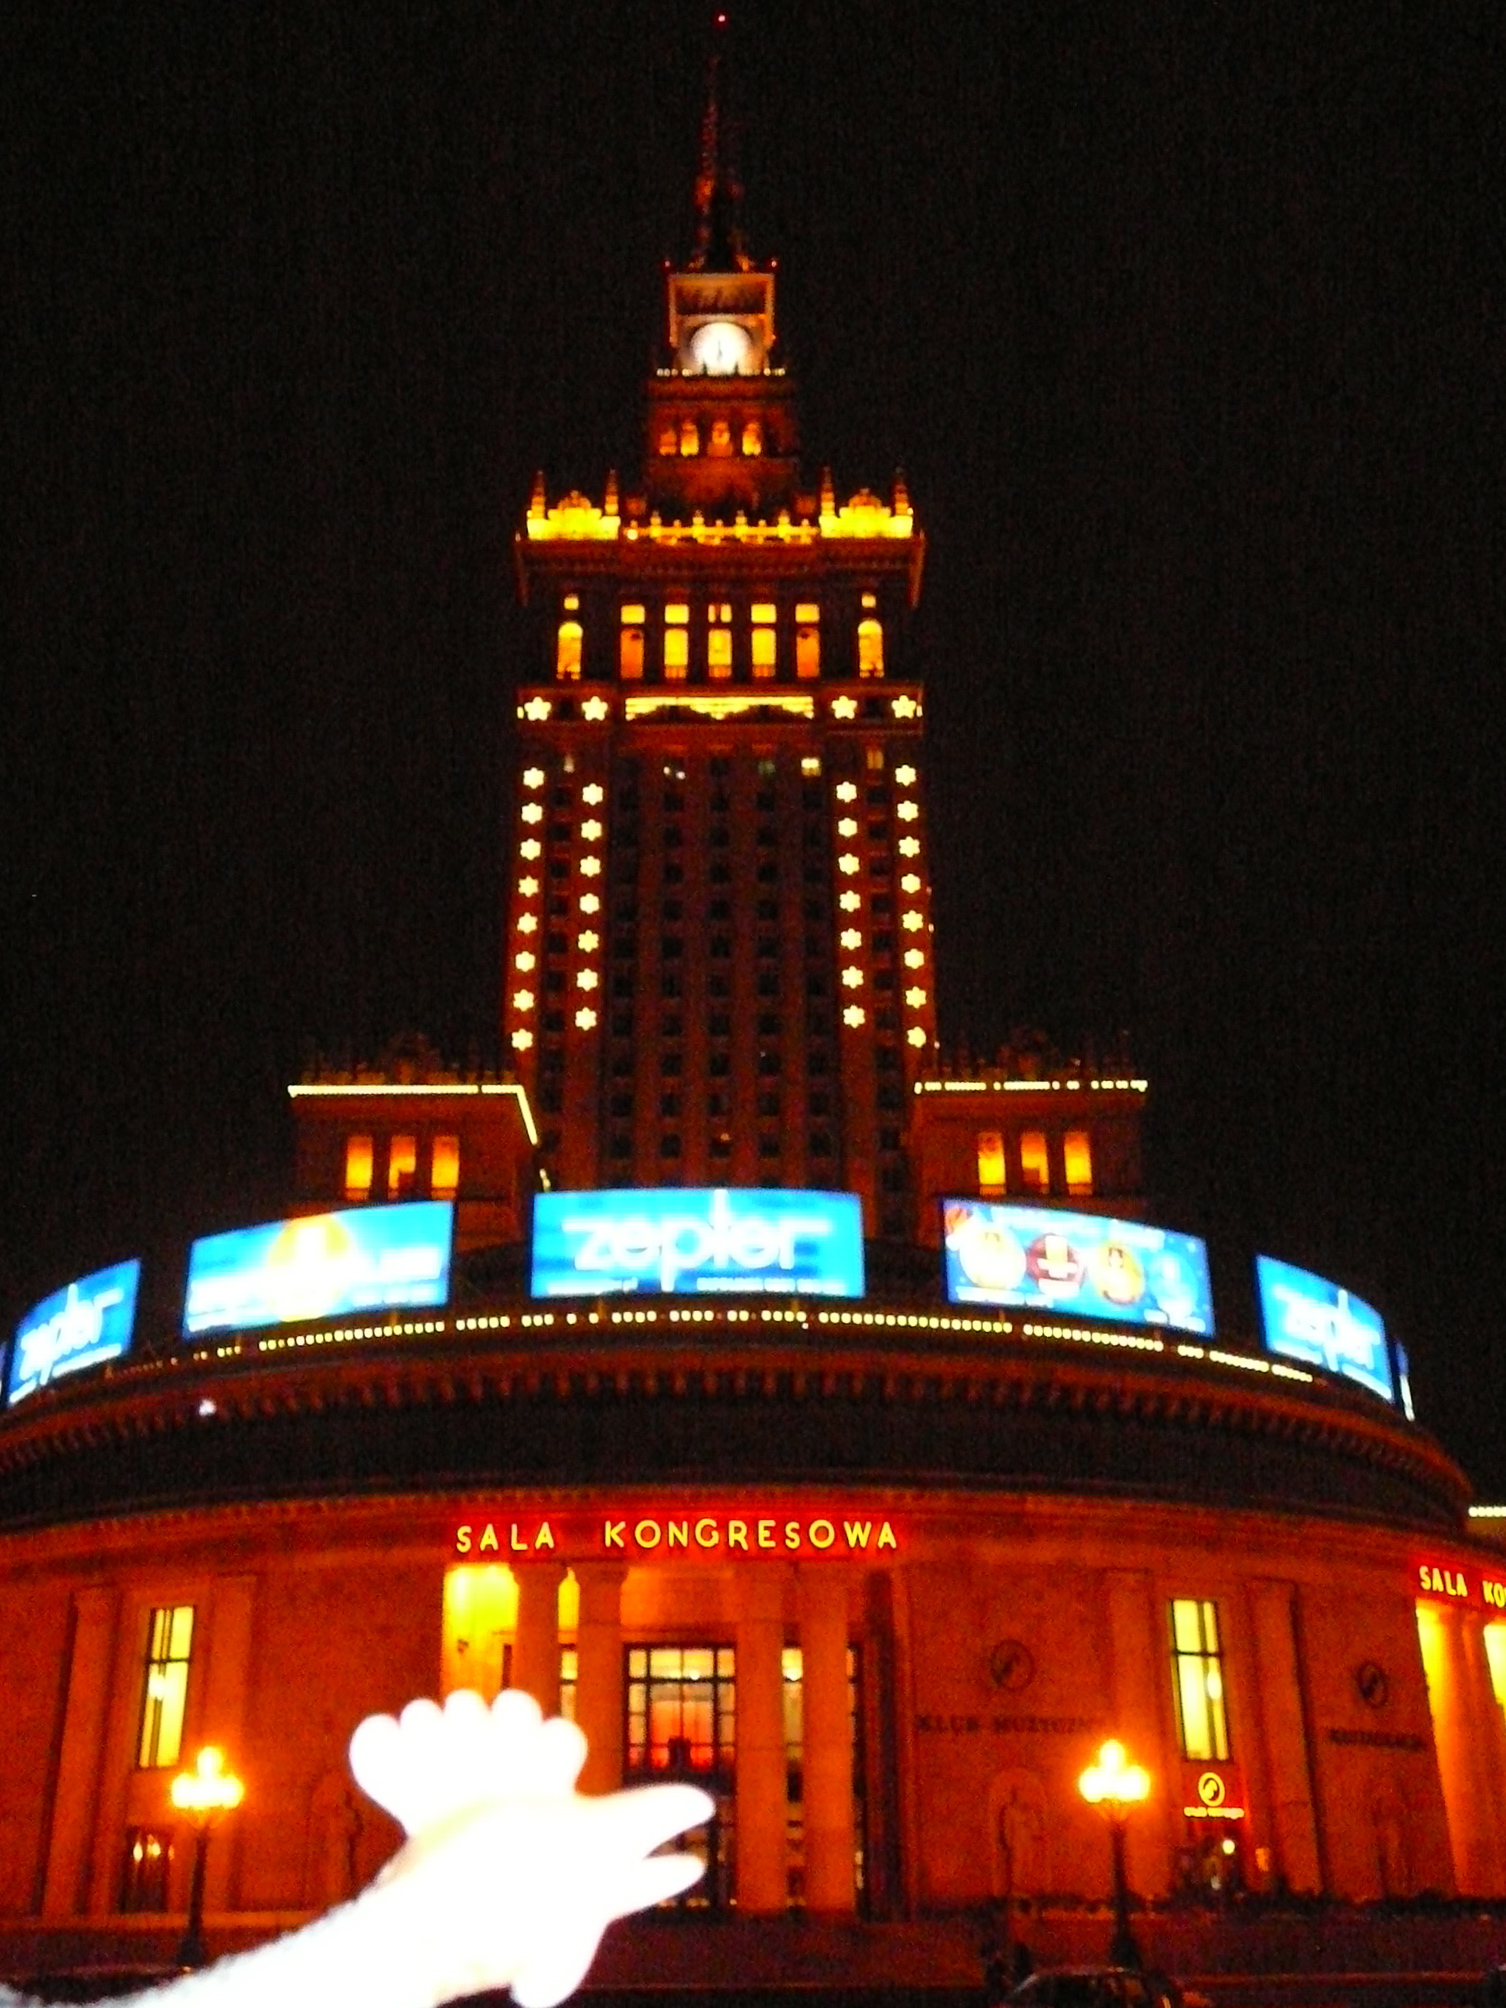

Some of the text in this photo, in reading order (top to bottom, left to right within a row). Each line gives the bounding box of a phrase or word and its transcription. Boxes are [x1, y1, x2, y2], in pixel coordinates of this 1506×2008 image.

[456, 1518, 897, 1553] SALA KONGRESOWA
[1419, 1565, 1506, 1608] SALA KO
